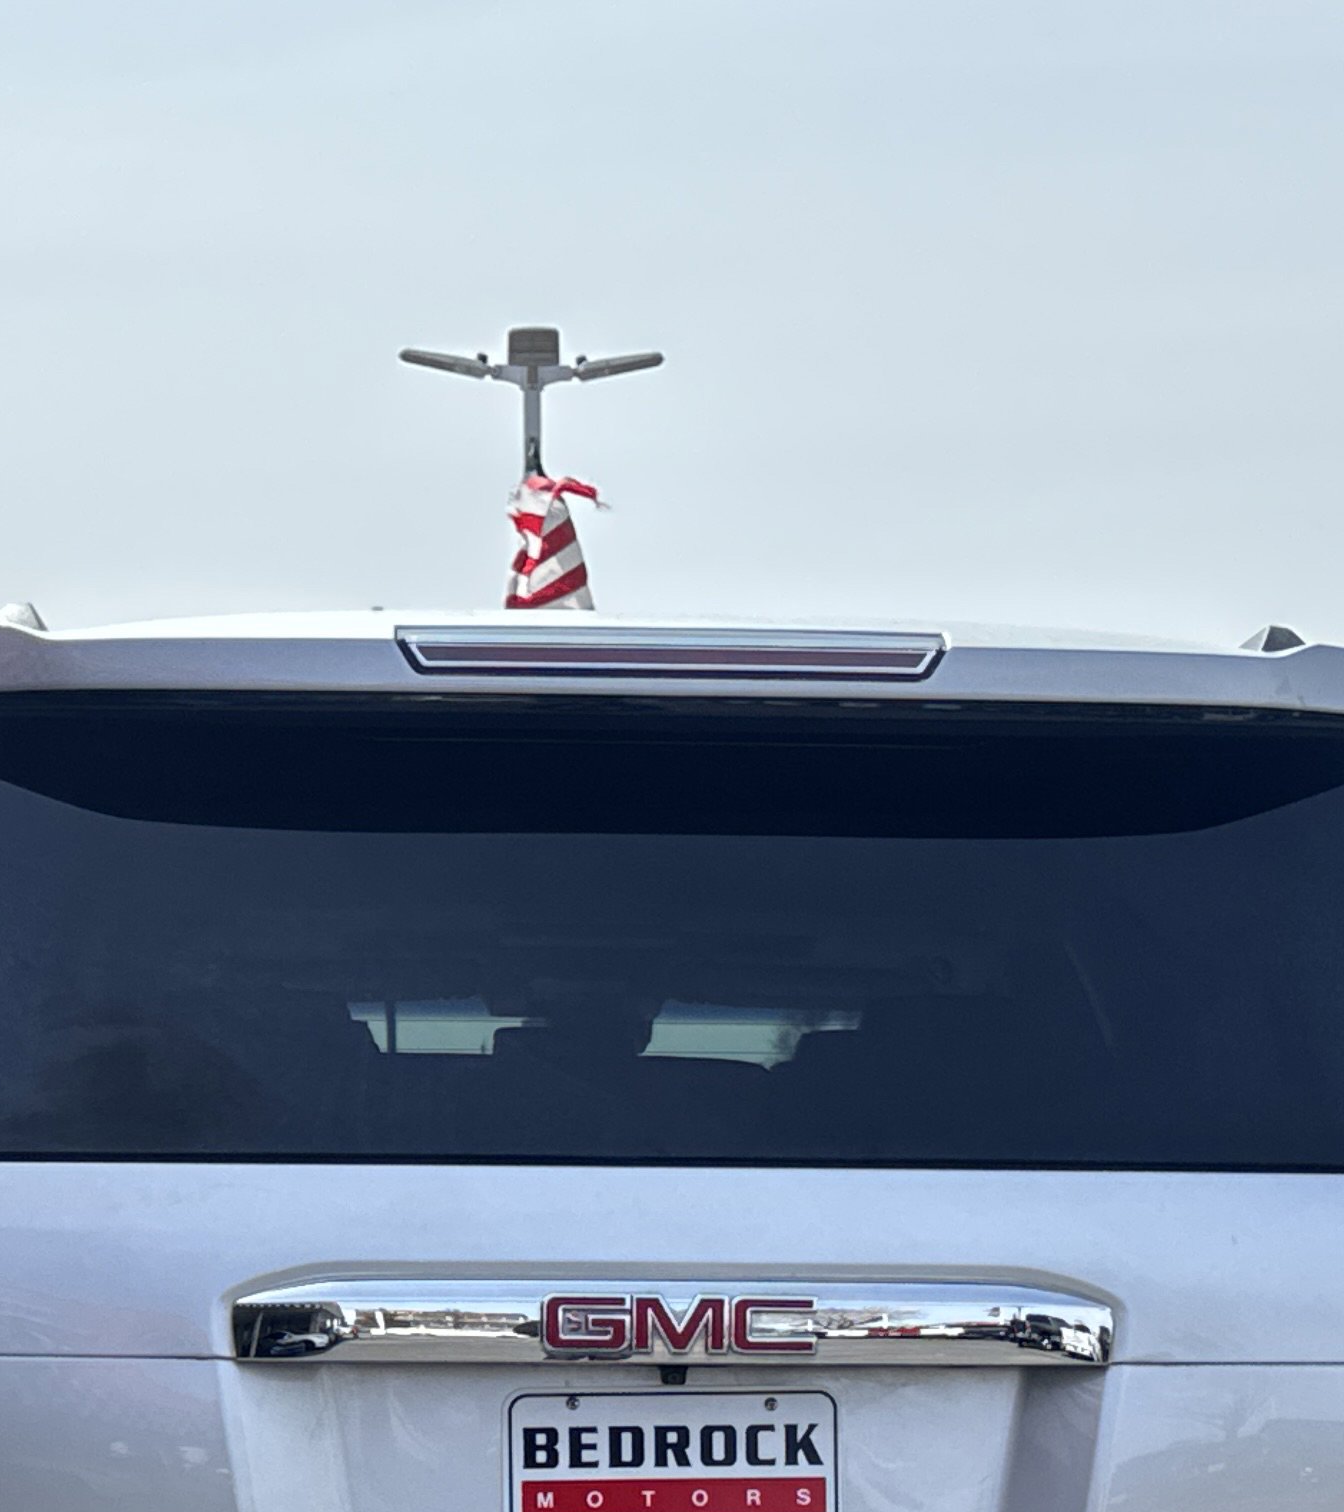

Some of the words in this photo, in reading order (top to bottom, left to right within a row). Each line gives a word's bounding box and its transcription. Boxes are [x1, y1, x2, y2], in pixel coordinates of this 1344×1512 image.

[539, 1293, 819, 1358] GMC
[522, 1423, 825, 1469] BEDROCK
[535, 1488, 813, 1510] MOTORS
